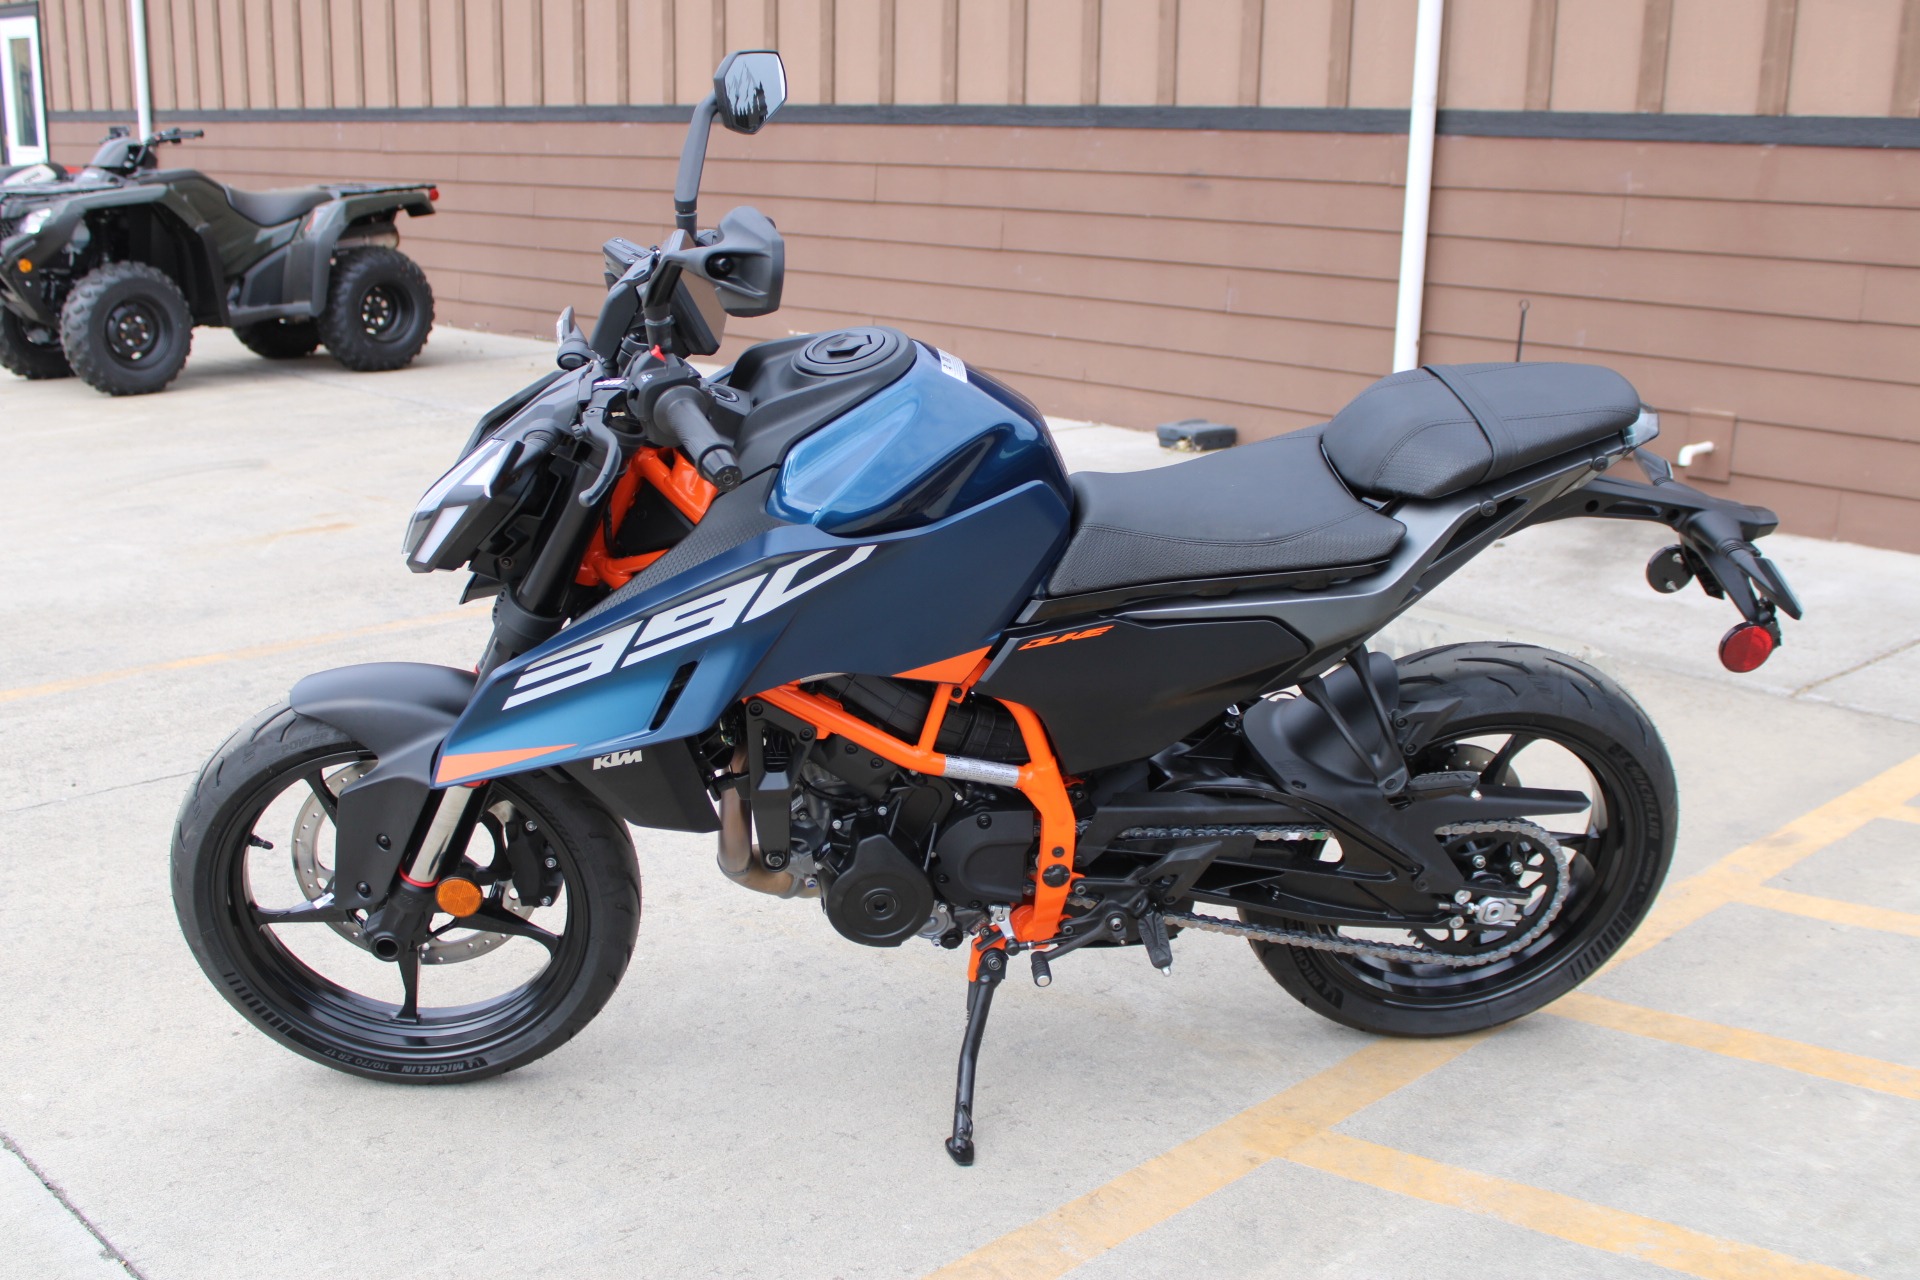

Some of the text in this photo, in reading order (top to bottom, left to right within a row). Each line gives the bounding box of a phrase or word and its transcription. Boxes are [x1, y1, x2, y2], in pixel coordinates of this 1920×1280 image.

[502, 545, 878, 710] 390
[592, 749, 643, 771] KTM
[1626, 764, 1661, 841] MICHELIN
[323, 1048, 465, 1075] MICHELIN 110/70 ZR 17
